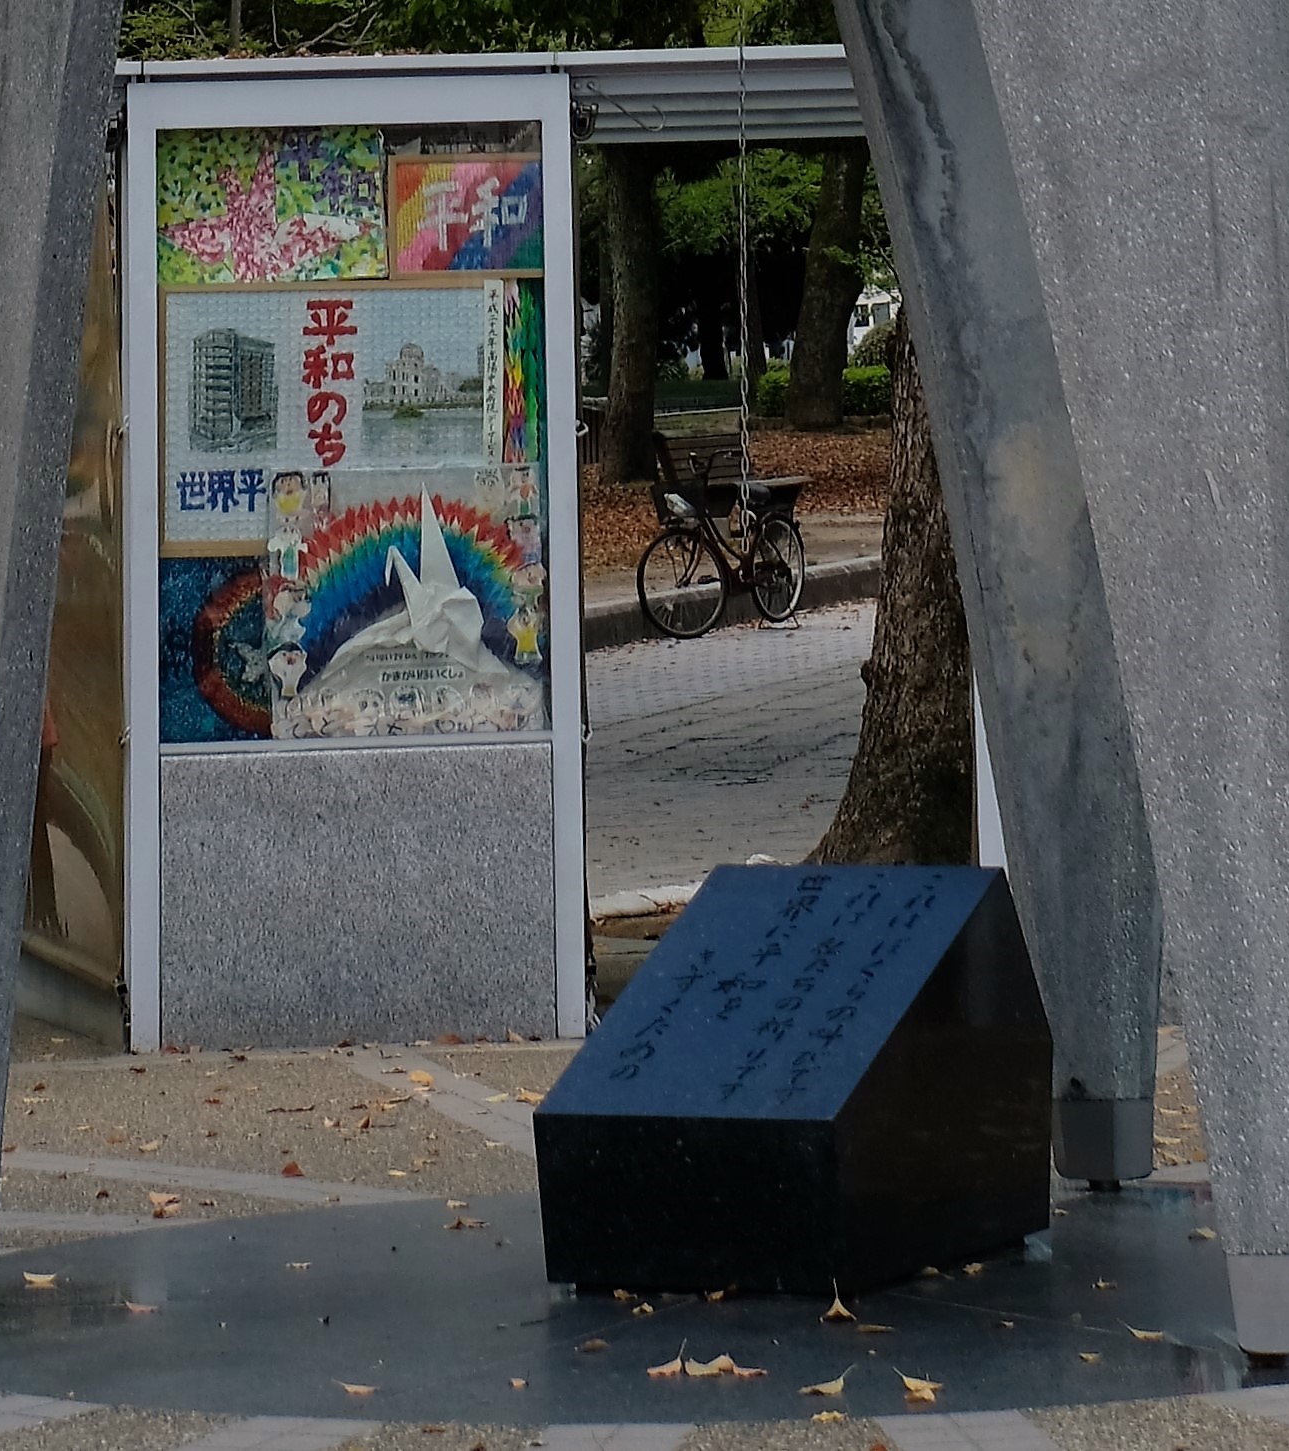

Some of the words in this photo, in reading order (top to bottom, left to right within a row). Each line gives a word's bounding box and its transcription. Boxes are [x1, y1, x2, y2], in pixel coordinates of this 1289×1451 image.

[277, 127, 376, 215] 平和
[416, 177, 528, 252] 平和
[301, 299, 358, 467] 平和のち
[710, 874, 832, 1021] 世界に平和を
